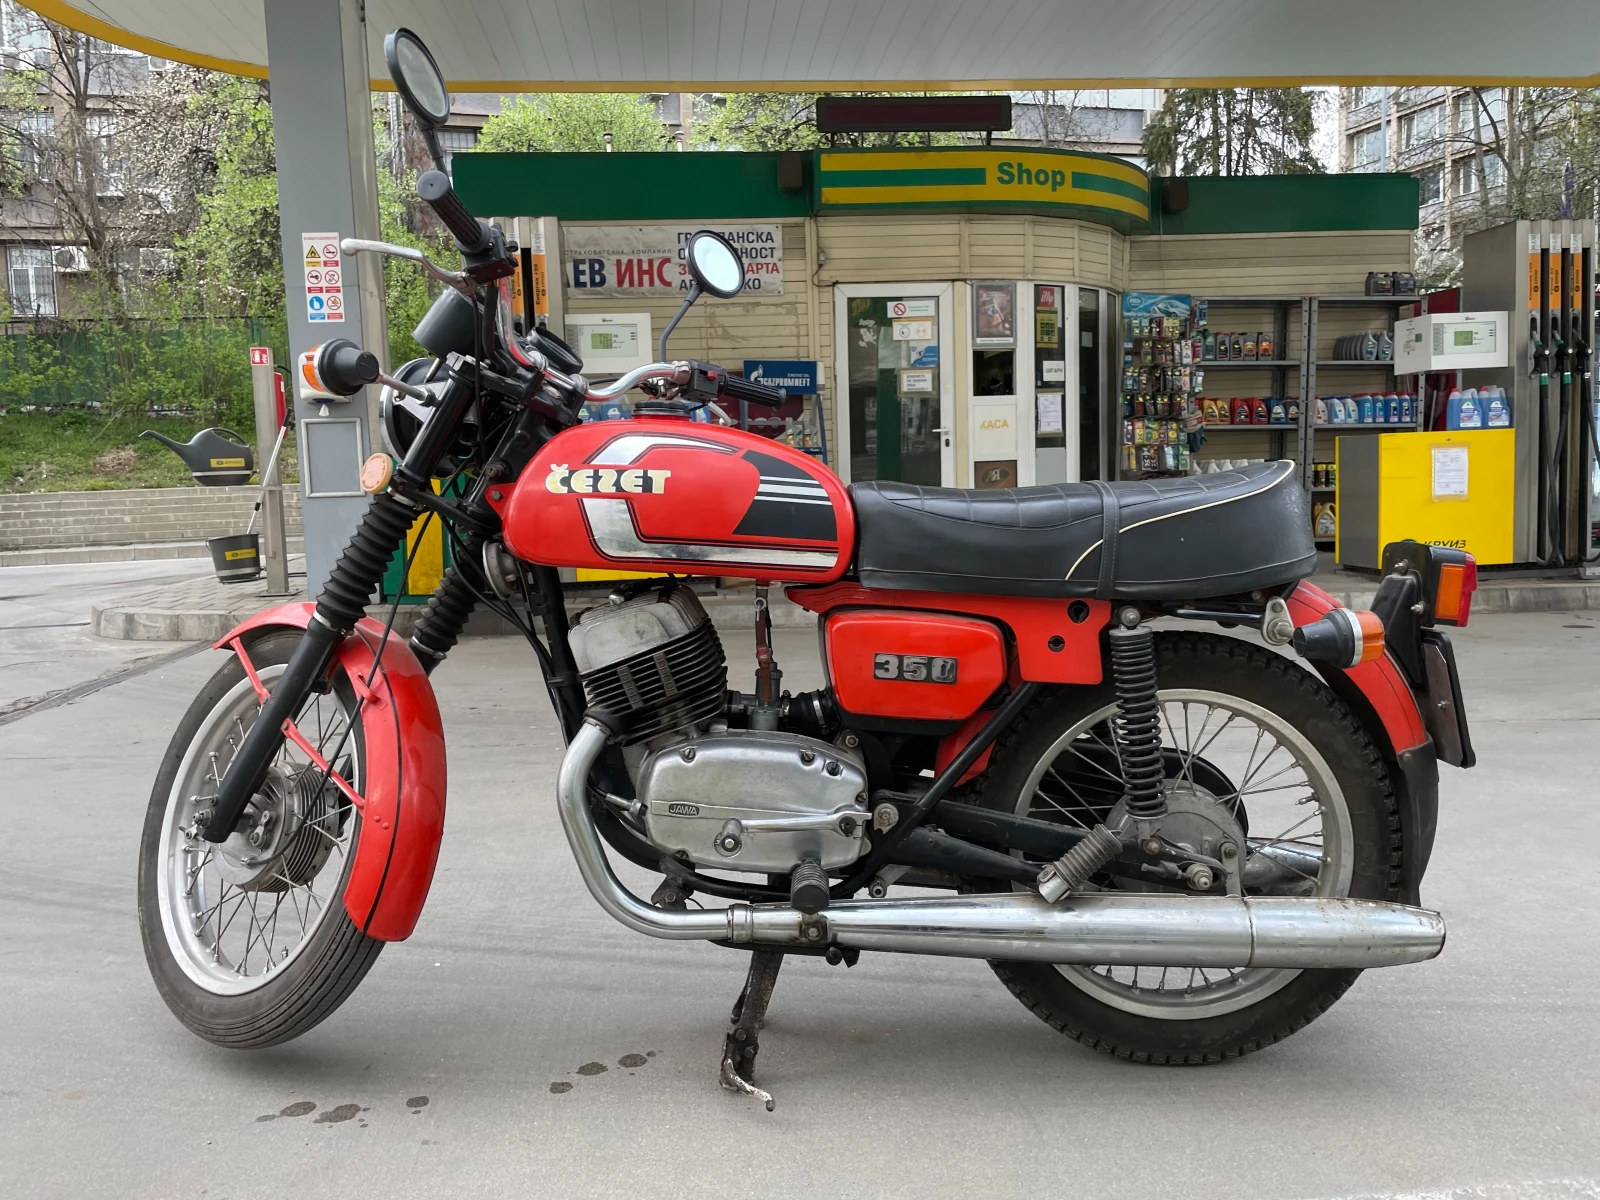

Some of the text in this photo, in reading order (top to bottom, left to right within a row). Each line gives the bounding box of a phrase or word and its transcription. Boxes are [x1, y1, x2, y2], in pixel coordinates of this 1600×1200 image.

[997, 162, 1065, 192] Shop
[565, 258, 607, 288] ЕВ
[616, 257, 673, 288] ИНС
[1040, 290, 1054, 305] illy
[764, 378, 810, 387] GAZPROMNEFT
[980, 419, 1009, 430] КАСА
[545, 464, 671, 494] ČEZET
[874, 653, 957, 684] 350
[670, 805, 697, 816] JAWA
